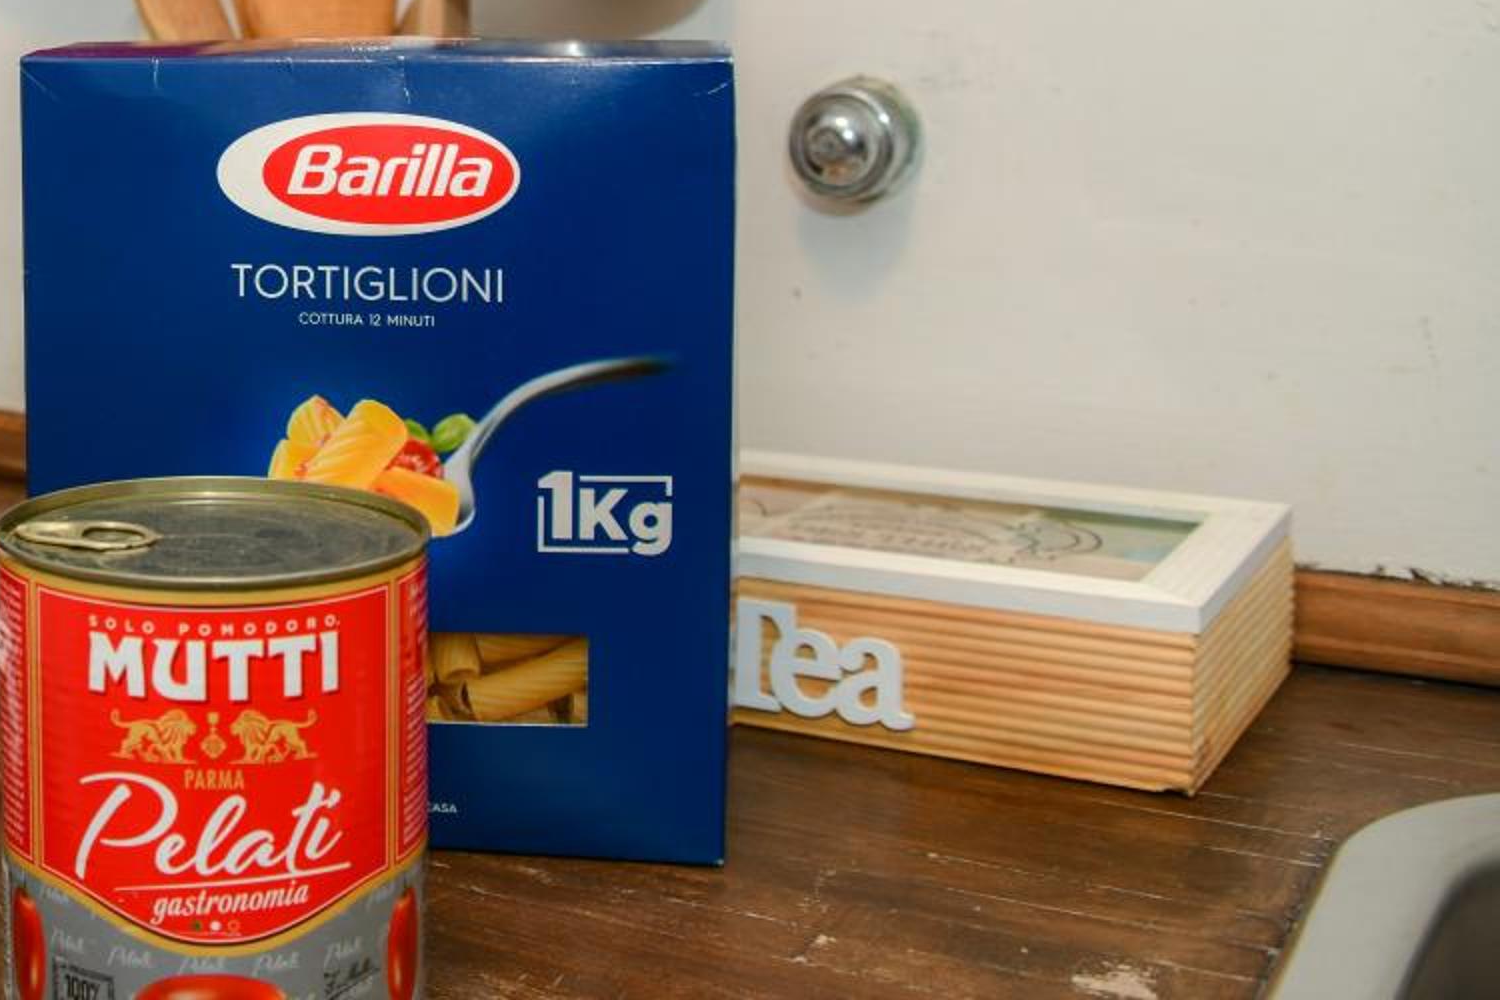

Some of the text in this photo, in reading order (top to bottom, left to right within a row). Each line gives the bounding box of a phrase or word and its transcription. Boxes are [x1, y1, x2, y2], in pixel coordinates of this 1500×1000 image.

[287, 144, 494, 197] Barilla
[231, 263, 504, 303] TORTIGLIONI
[298, 311, 435, 328] COTTURA 12 MINUTI
[88, 614, 336, 636] SOLO POMODORO
[88, 630, 339, 701] MUTTI
[186, 770, 245, 790] PARMA
[75, 771, 344, 880] Pelati
[151, 883, 309, 925] gastronomia
